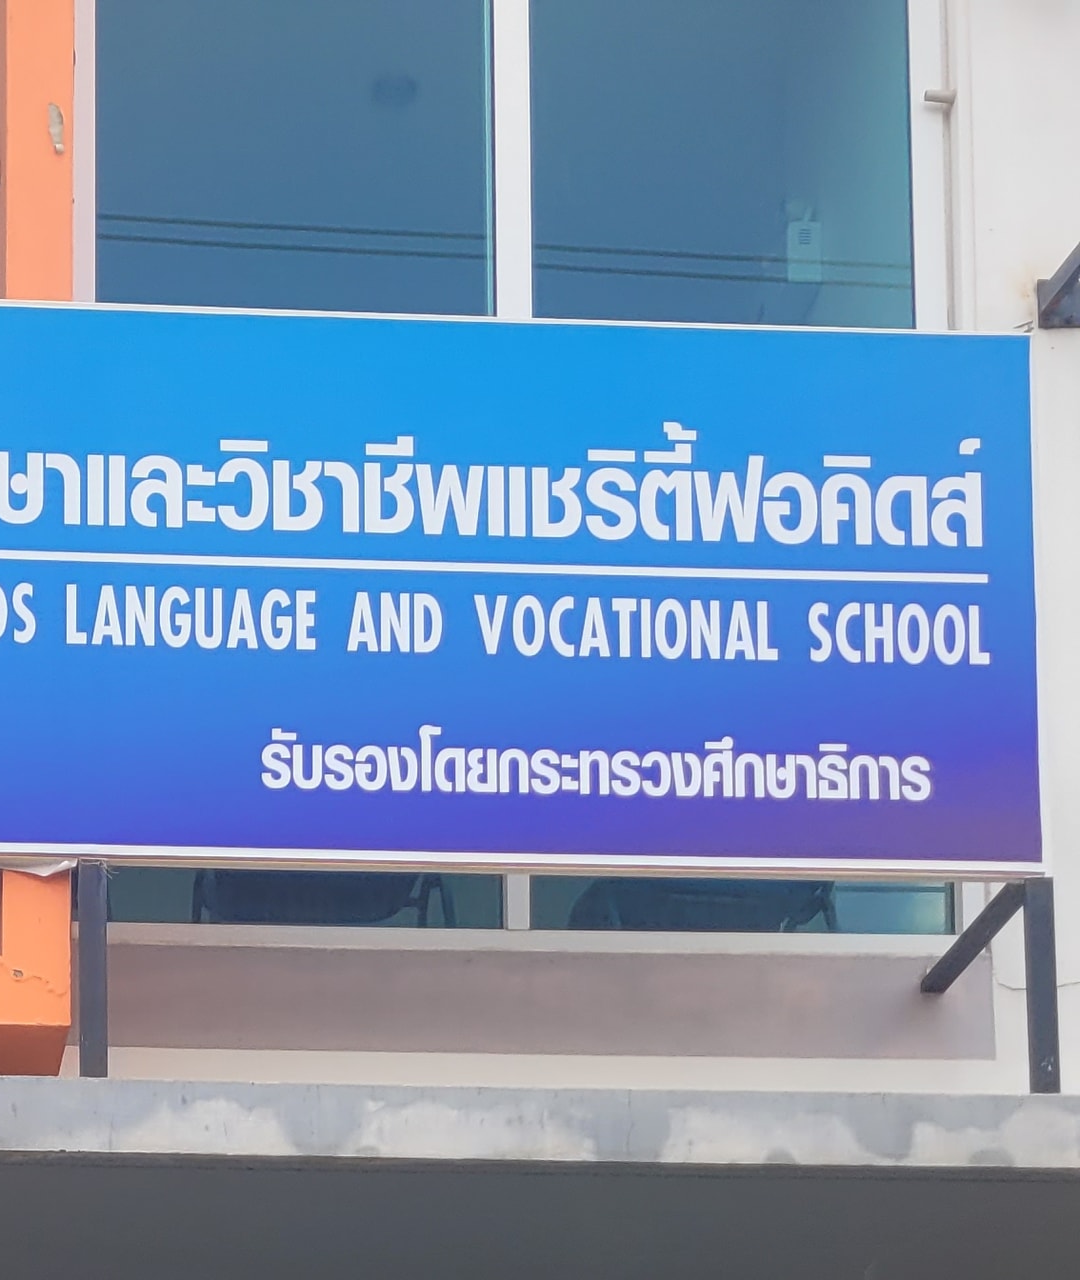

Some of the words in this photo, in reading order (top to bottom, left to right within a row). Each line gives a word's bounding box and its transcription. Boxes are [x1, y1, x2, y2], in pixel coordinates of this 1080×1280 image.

[66, 583, 316, 650] LANGUAGE
[347, 591, 443, 653] AND
[474, 594, 779, 661] VOCATIONAL
[808, 602, 991, 665] SCHOOL
[260, 724, 932, 802] รับรองโดยกระทรวงศึกษาธิการ
